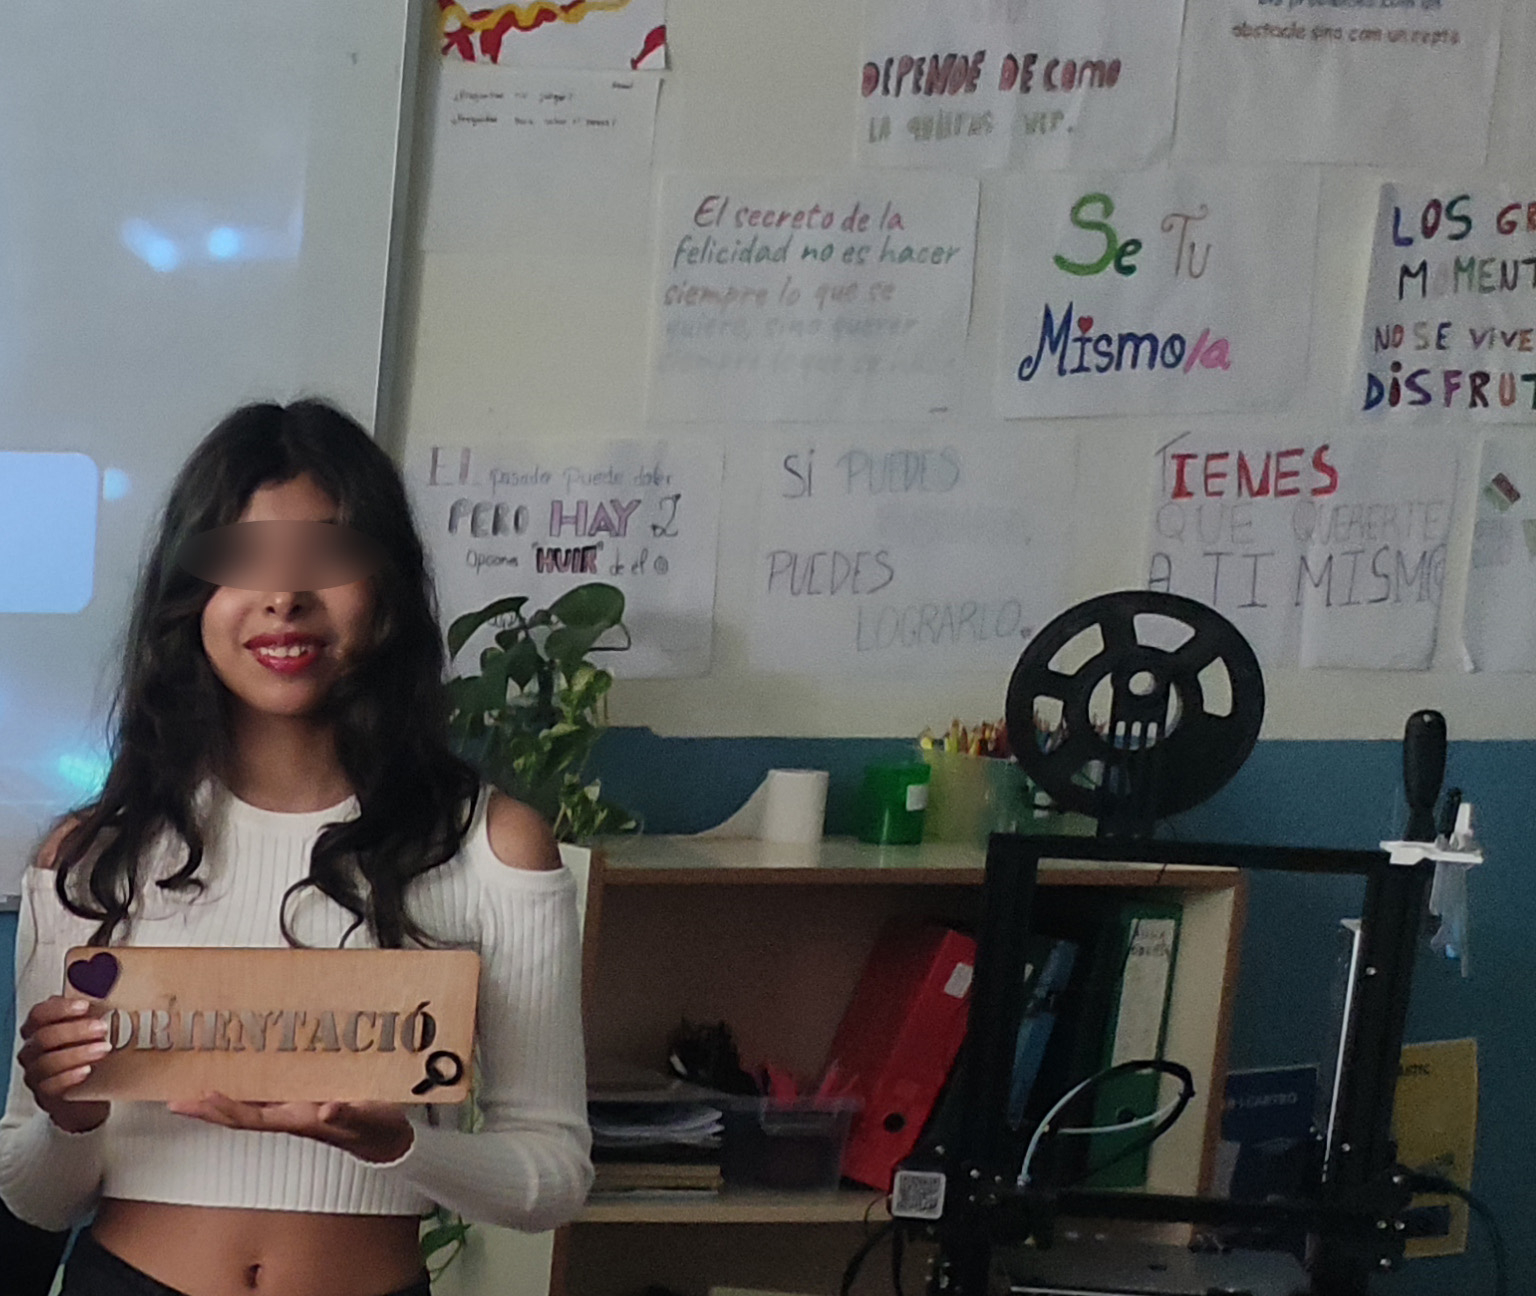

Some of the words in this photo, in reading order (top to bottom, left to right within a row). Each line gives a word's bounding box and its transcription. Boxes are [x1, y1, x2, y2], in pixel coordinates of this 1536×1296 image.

[998, 53, 1038, 94] DE
[693, 195, 729, 229] El
[734, 202, 834, 231] secreto
[840, 201, 871, 233] de
[879, 201, 906, 232] la
[1053, 192, 1143, 277] Se
[1392, 193, 1473, 248] LOS
[673, 234, 795, 269] felicidad
[801, 242, 834, 264] no
[841, 243, 870, 266] es
[879, 234, 961, 266] hacer
[663, 281, 769, 315] siempre
[778, 274, 801, 306] lo
[815, 281, 859, 312] que
[868, 281, 897, 303] se
[1375, 323, 1405, 352] NO
[1414, 320, 1453, 351] SE
[836, 446, 961, 495] PUEDES
[447, 498, 529, 538] PERO
[549, 499, 642, 537] HAY
[1156, 501, 1254, 545] QUE
[766, 549, 895, 597] PUEDES
[106, 1000, 437, 1054] ORIENTACIÓ
